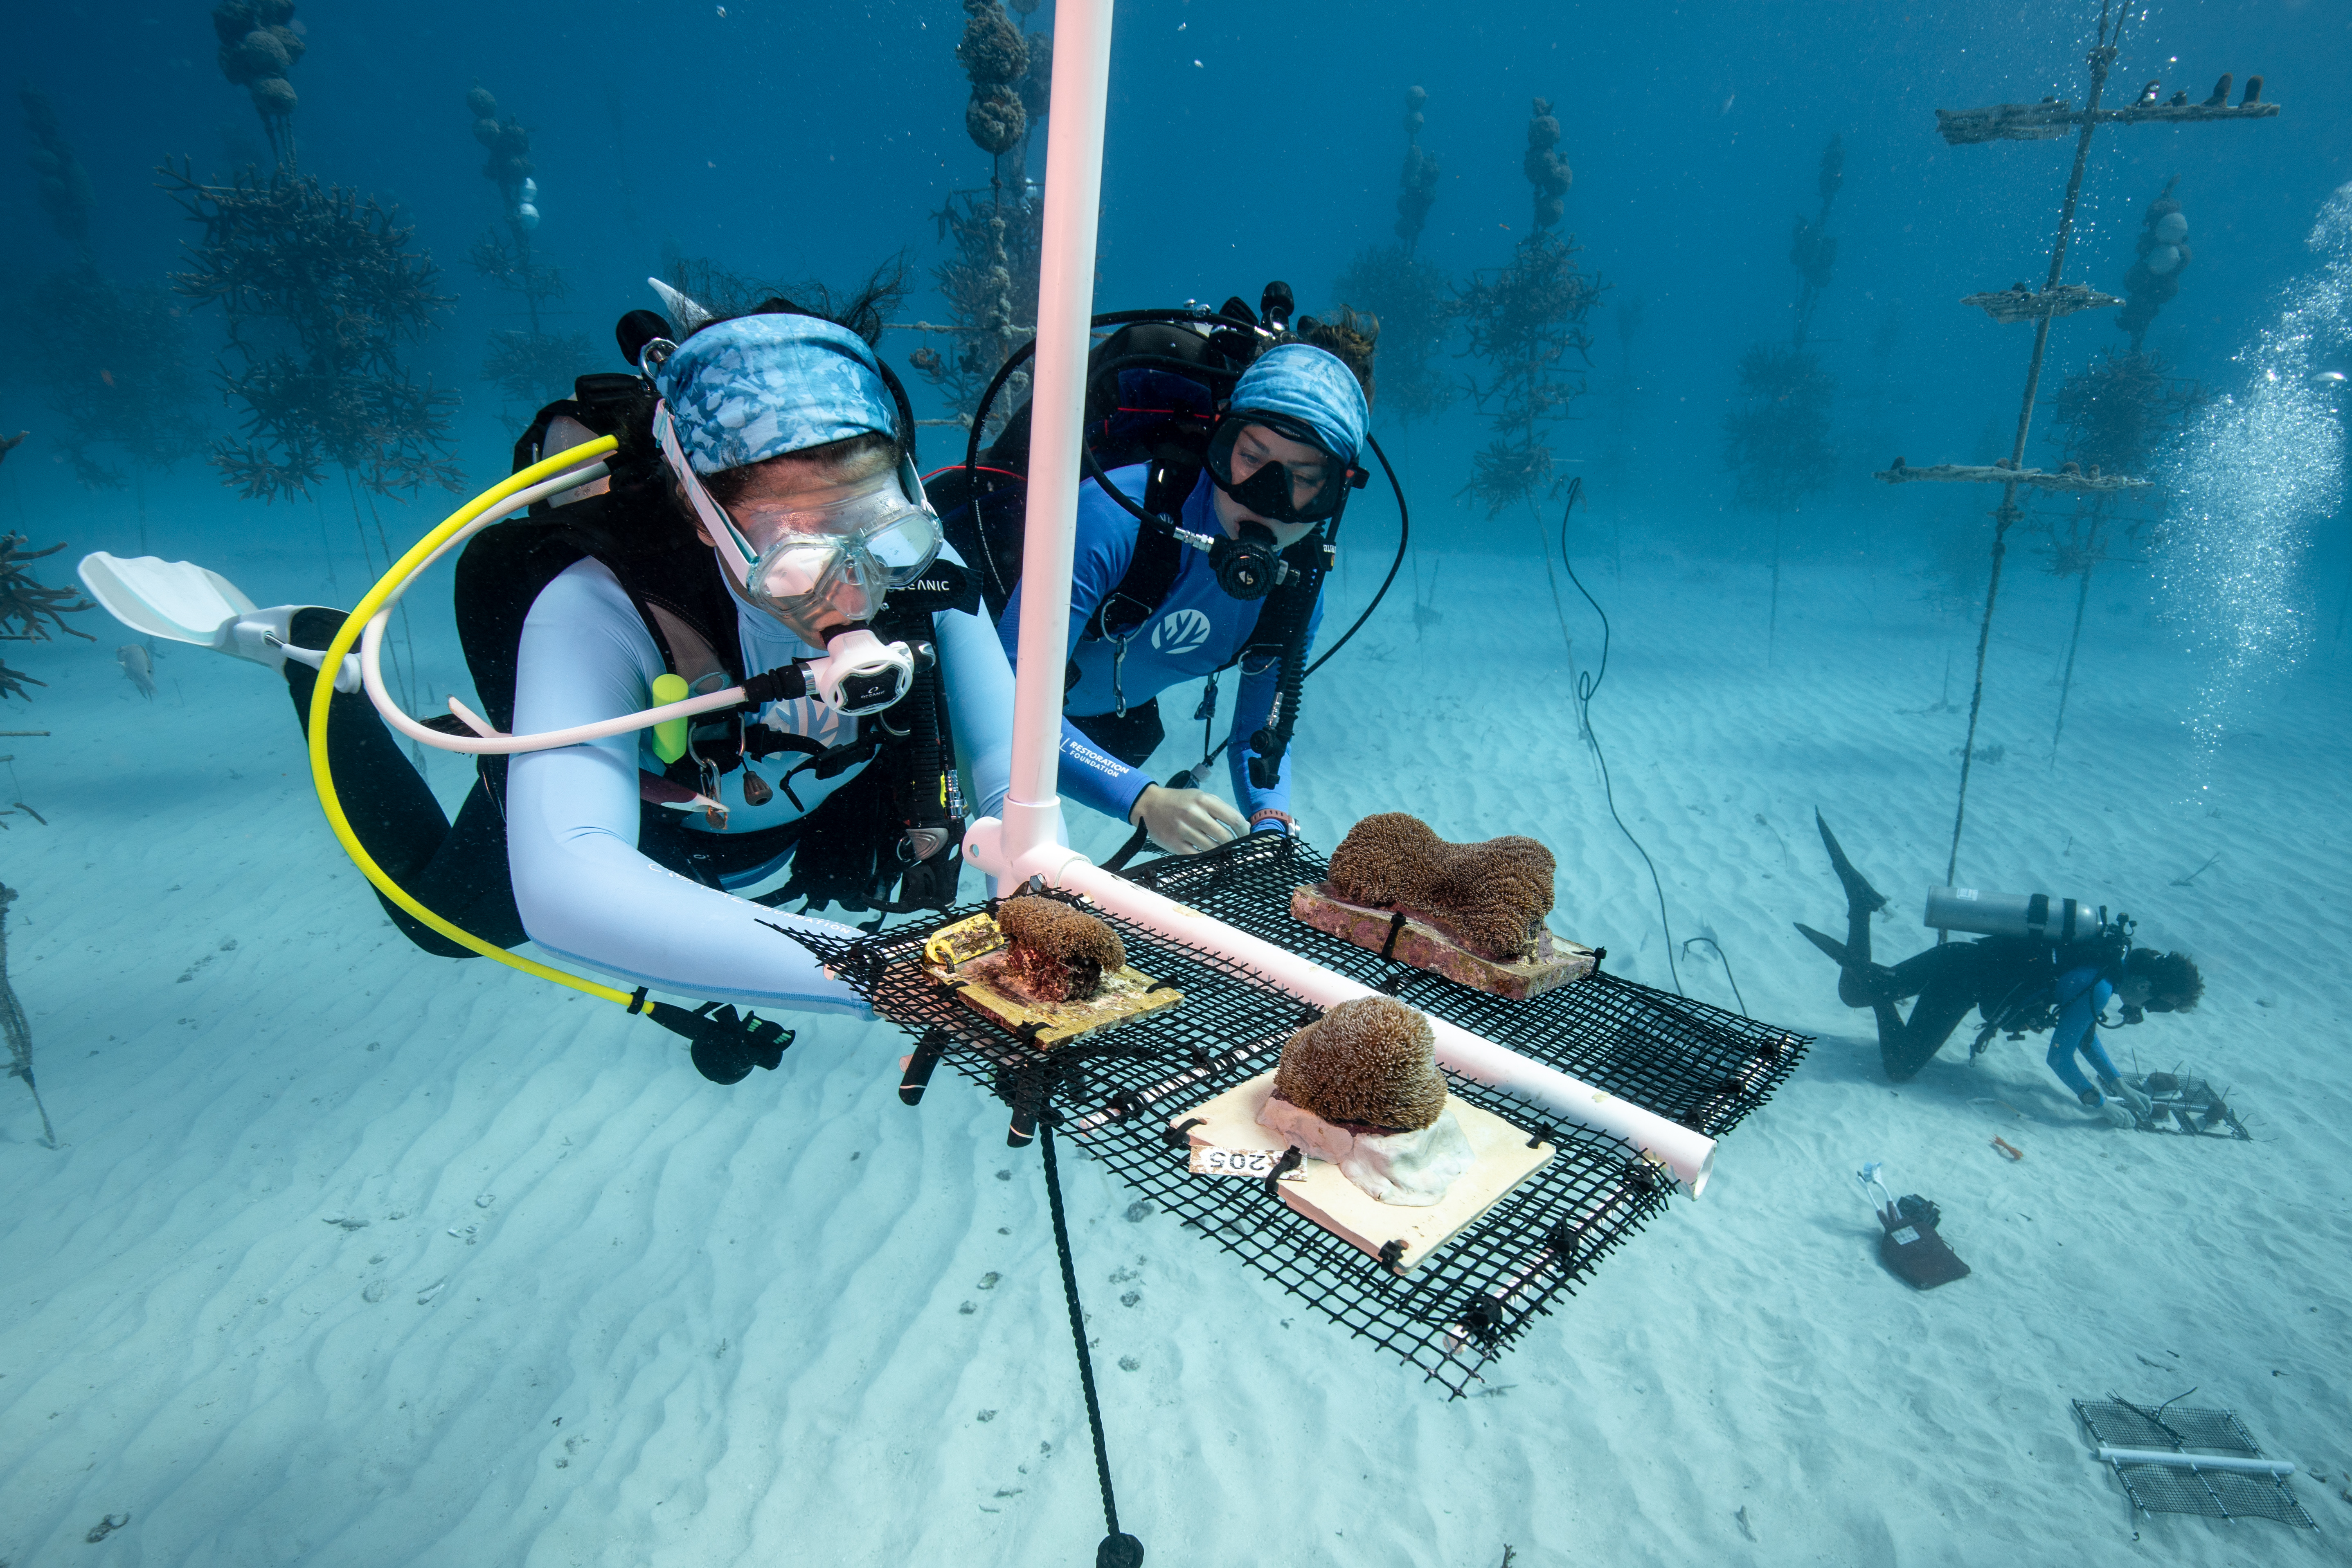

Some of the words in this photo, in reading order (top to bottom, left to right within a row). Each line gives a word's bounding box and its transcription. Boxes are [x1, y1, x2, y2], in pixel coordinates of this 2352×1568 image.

[860, 690, 886, 699] OCEANIC
[1069, 741, 1130, 774] RESTORATION
[1069, 750, 1119, 778] FOUNDATION
[753, 904, 851, 934] FOUNDATION
[1209, 1152, 1266, 1171] 205
